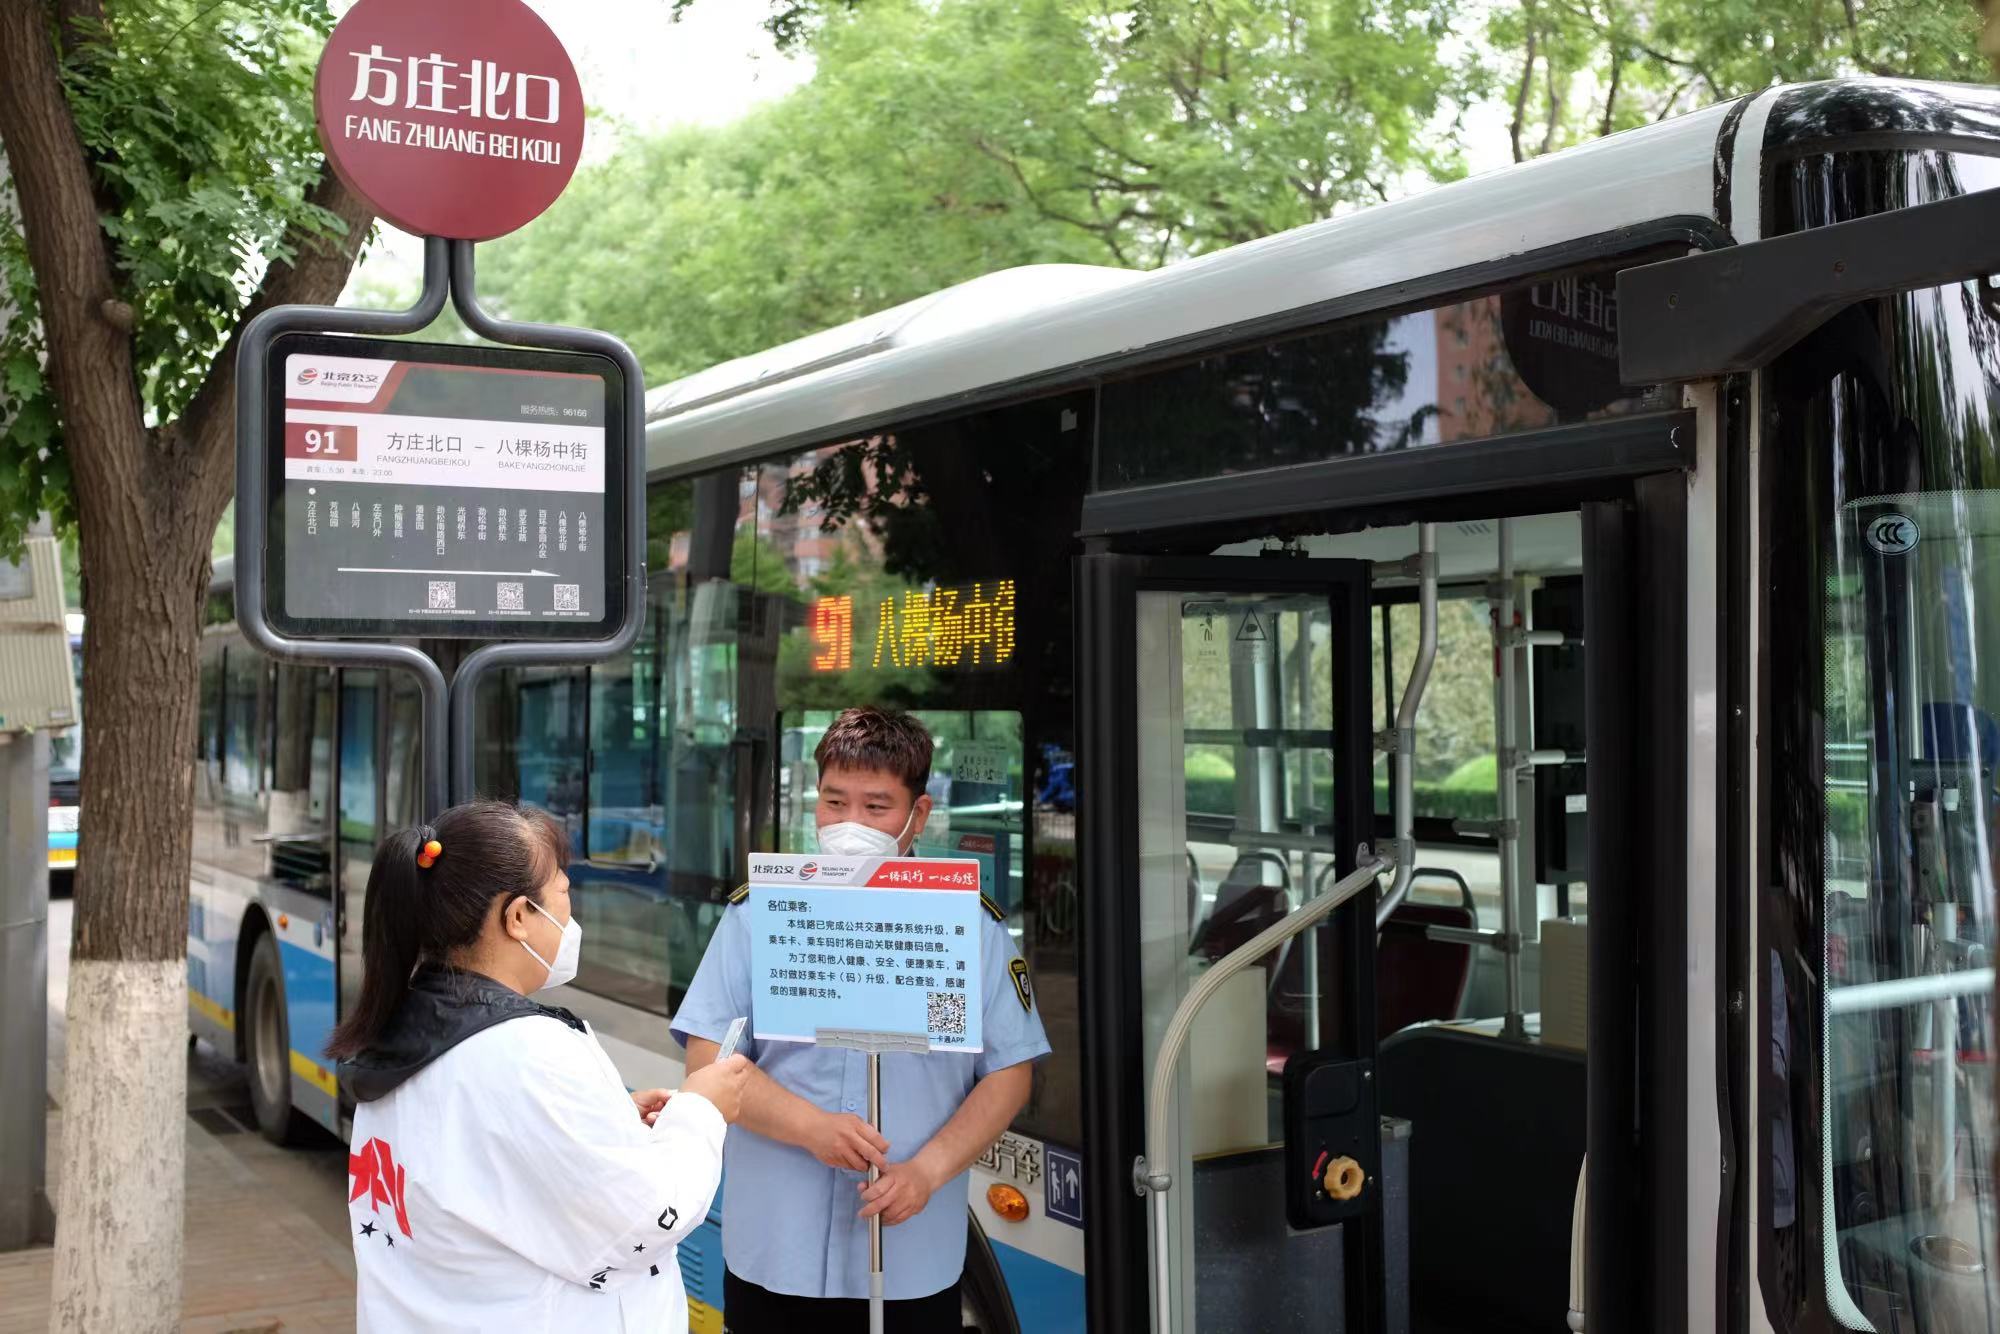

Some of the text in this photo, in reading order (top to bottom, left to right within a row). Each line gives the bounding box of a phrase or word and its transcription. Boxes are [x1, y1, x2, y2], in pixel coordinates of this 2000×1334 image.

[349, 44, 560, 124] 方庄北口
[345, 115, 561, 164] FANG ZHUANG BEI KOU
[322, 371, 379, 383] 北京公交
[304, 430, 339, 454] 91
[386, 431, 588, 461] 方庄北口 八棵杨中街
[376, 455, 586, 473] FANGZHUANGBEIKOU BAKEYANGZHONGJIE
[307, 500, 317, 535] 方庄北口
[351, 502, 360, 529] 八里河
[373, 503, 382, 537] 左安门外
[815, 596, 852, 670] 91
[752, 865, 794, 875] 北京公交
[929, 871, 976, 885] 一心为您
[768, 901, 813, 913] 各位乘客：
[770, 987, 842, 999] 您的理解和支持。
